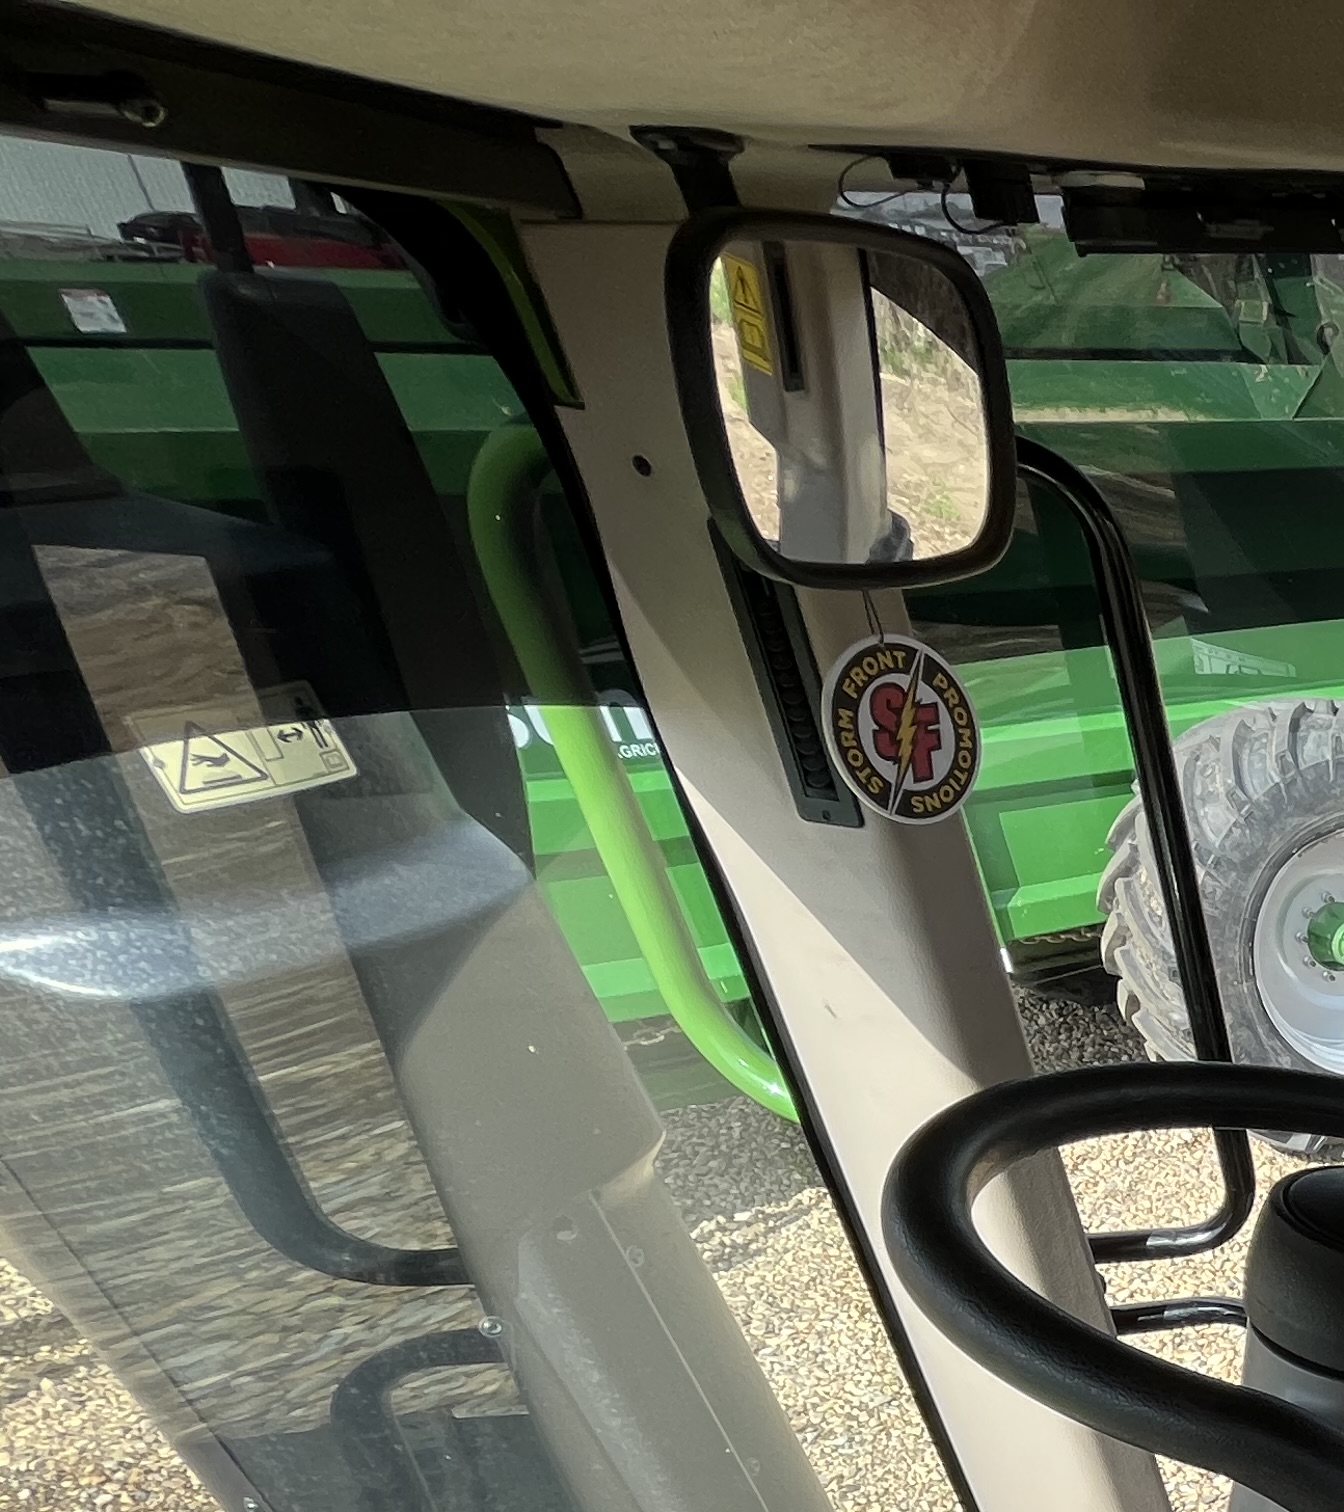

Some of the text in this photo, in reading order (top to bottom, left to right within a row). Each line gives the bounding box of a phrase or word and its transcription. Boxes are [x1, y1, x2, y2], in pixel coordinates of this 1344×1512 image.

[618, 742, 660, 759] GRIC
[837, 649, 907, 795] STORM FRONT
[910, 672, 974, 814] PROMOTIONS
